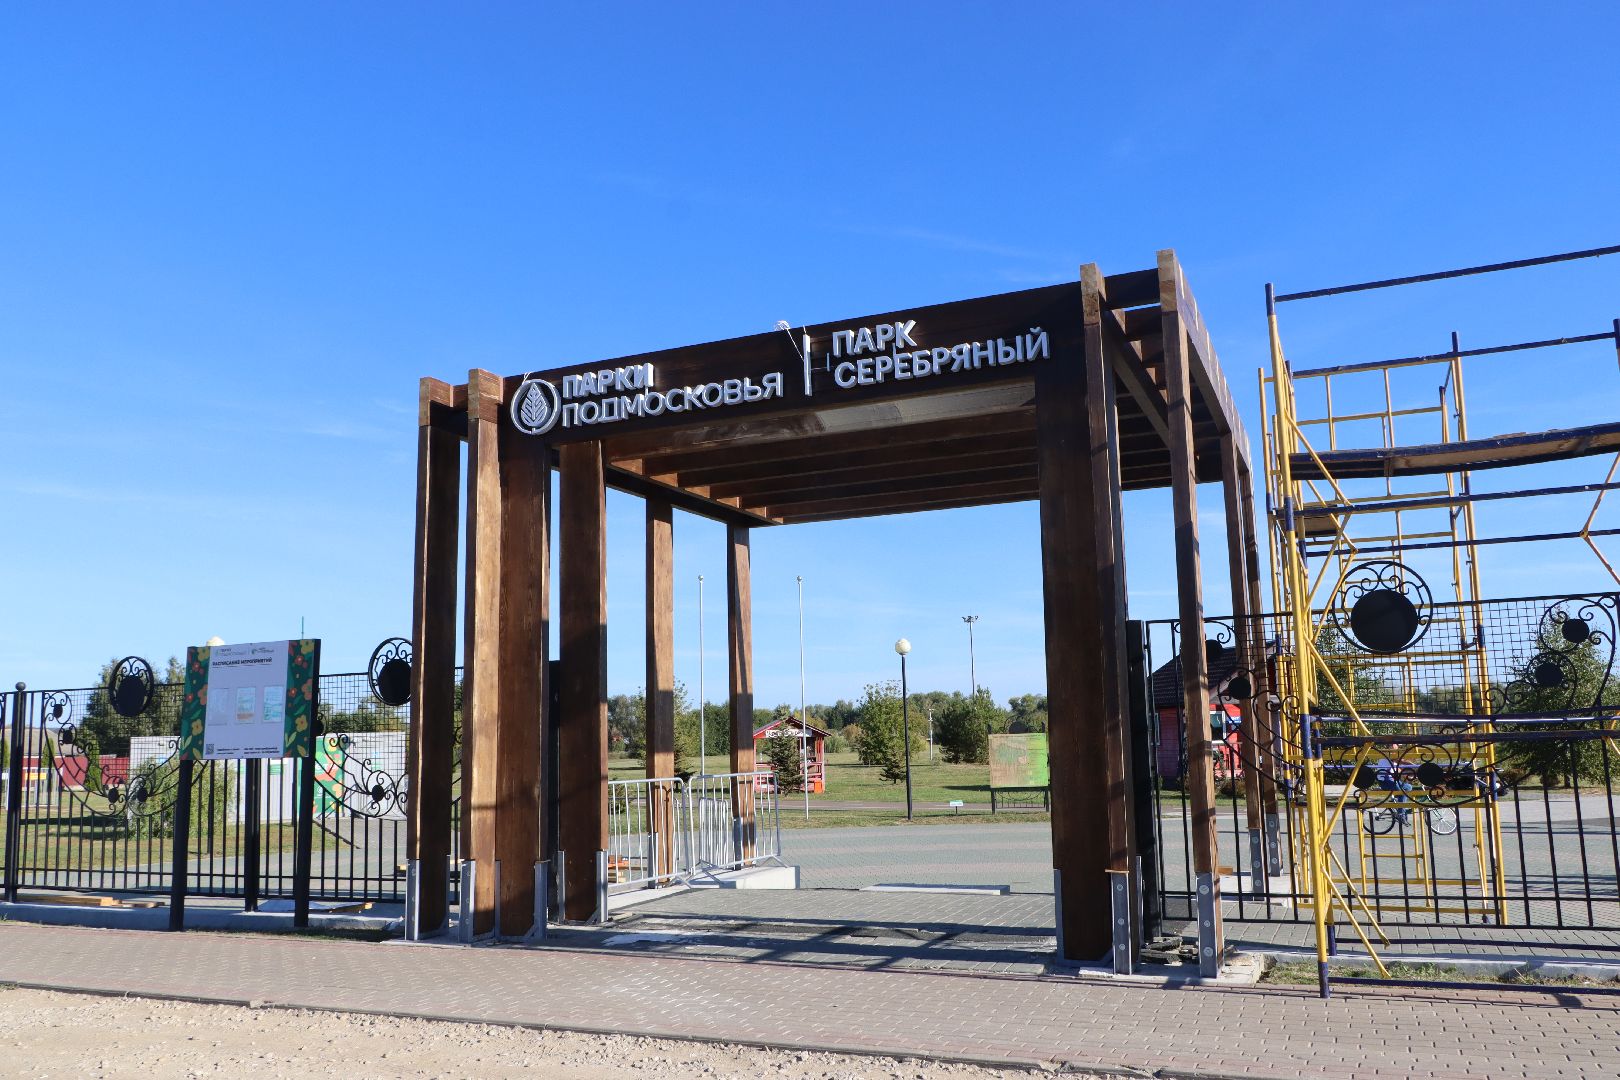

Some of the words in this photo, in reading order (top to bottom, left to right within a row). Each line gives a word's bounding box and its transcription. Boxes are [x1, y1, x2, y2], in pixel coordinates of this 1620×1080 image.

[832, 319, 918, 358] ПАРК
[834, 326, 1051, 389] СЕРЕБРЯНЫЙ
[562, 362, 655, 399] ПАРКИ
[562, 371, 784, 428] ПОДМОСКОВЬЯ
